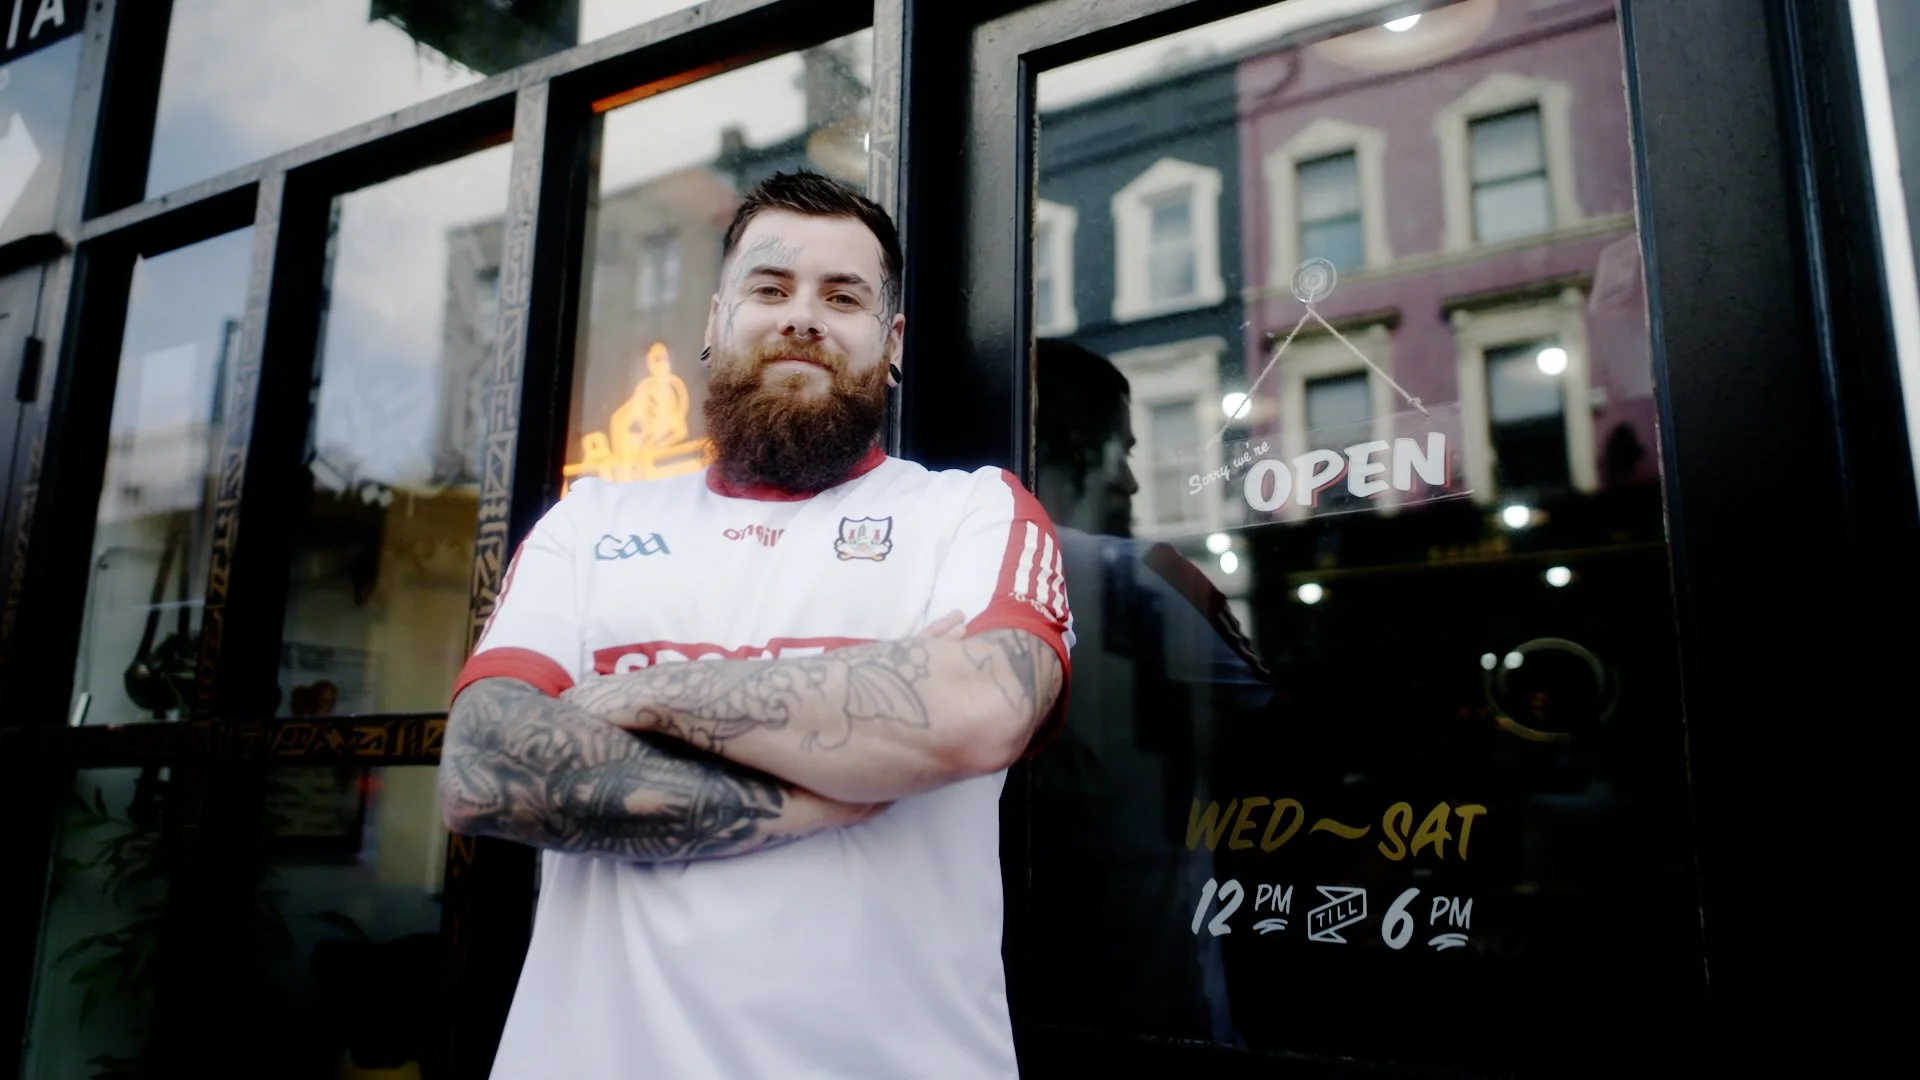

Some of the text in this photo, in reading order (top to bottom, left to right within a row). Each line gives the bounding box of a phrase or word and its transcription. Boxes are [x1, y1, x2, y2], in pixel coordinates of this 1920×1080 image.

[1189, 441, 1271, 495] Sorry we're
[1243, 431, 1449, 513] OPEN
[1191, 876, 1473, 950] 12 PM TILL 6 PM
